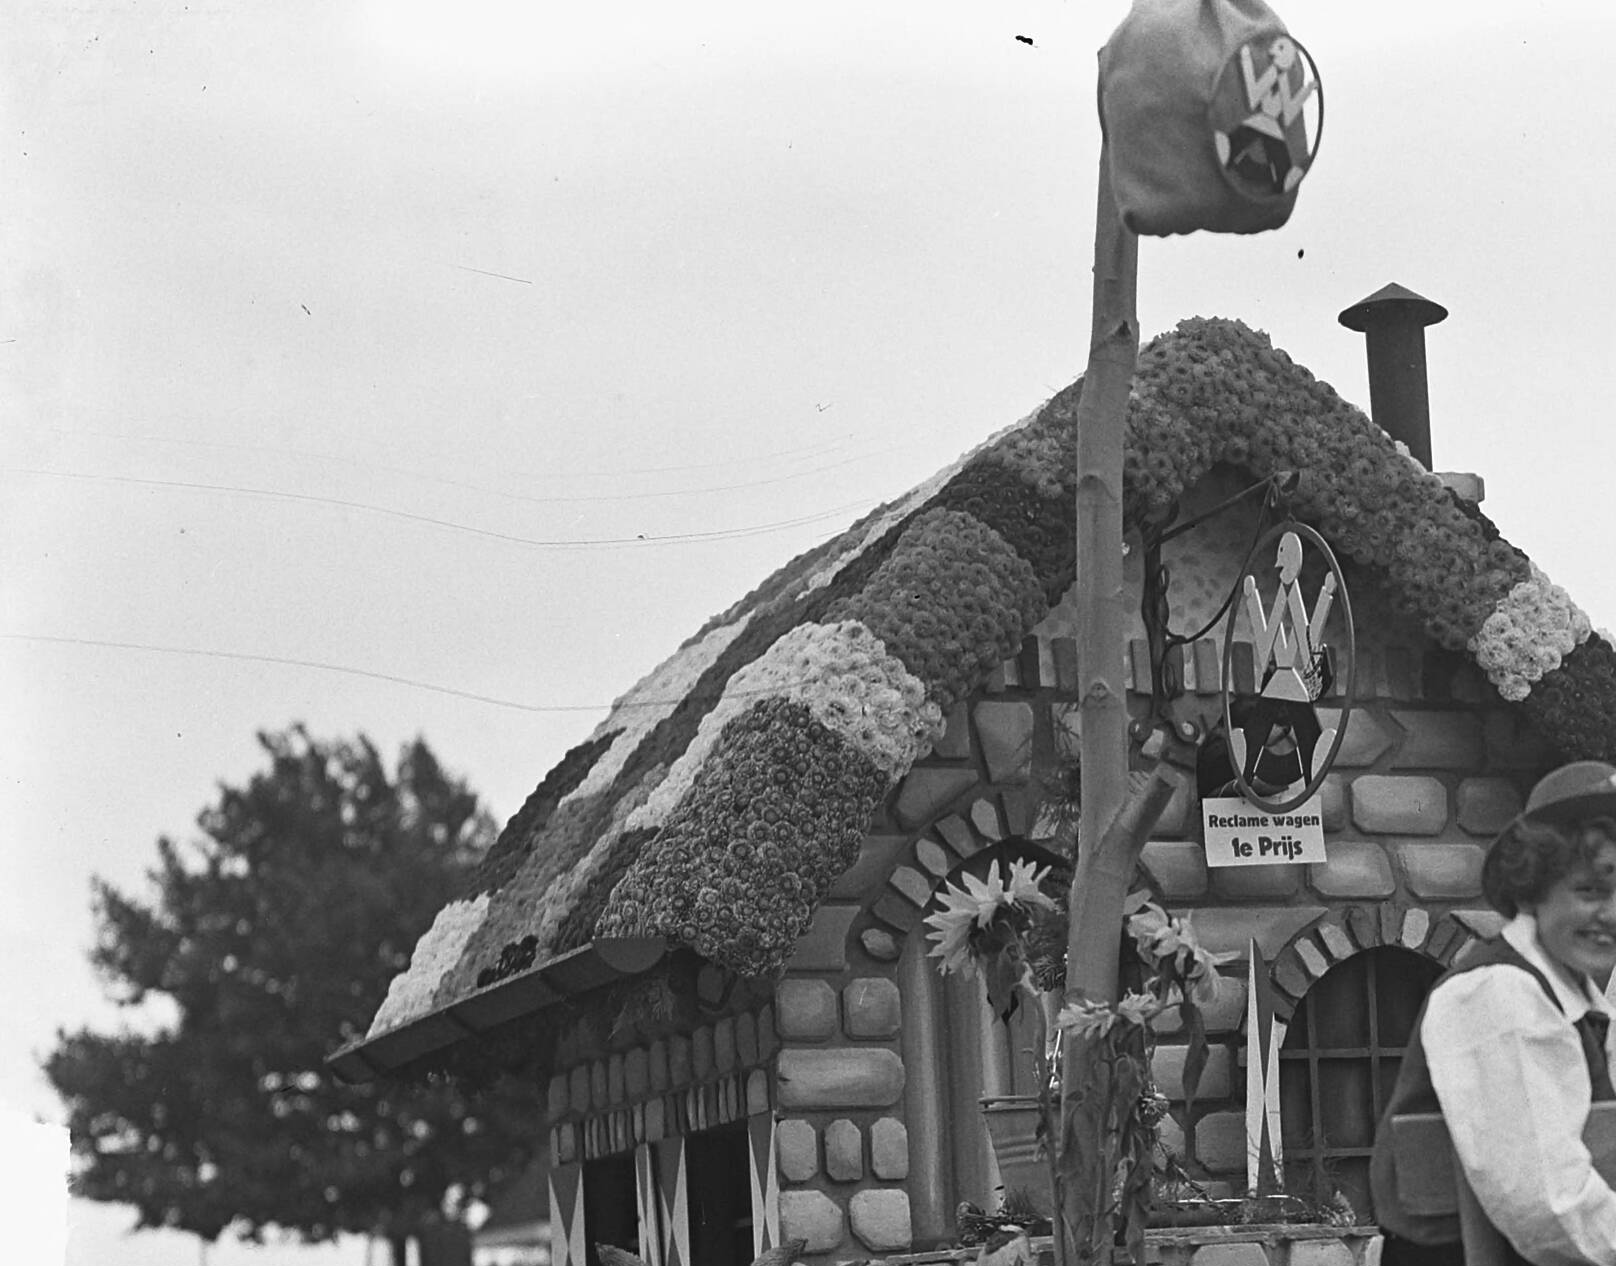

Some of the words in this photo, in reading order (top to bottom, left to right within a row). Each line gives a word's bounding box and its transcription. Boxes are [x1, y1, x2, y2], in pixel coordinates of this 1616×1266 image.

[1208, 814, 1269, 828] Reclame
[1272, 815, 1320, 829] wagen
[1231, 837, 1253, 857] 1e
[1258, 835, 1303, 861] Prijs
